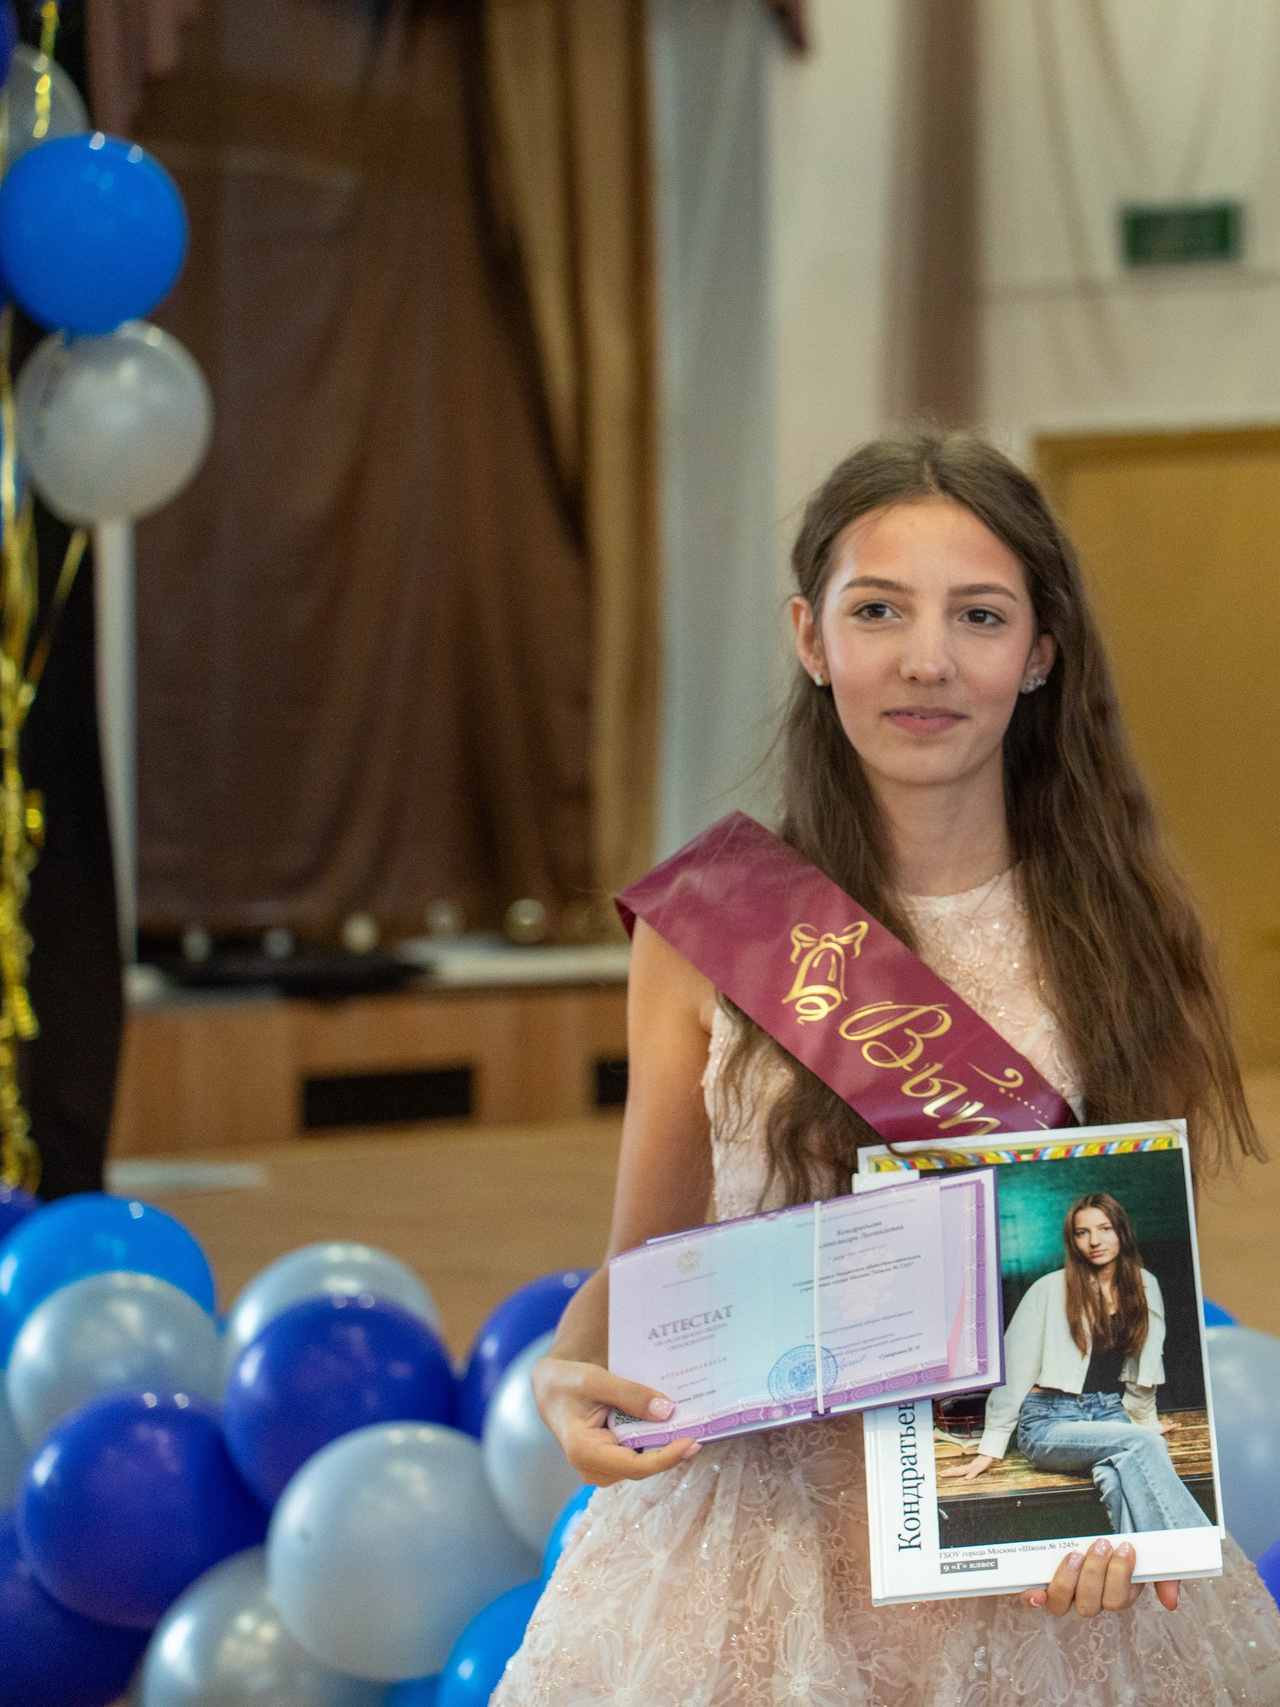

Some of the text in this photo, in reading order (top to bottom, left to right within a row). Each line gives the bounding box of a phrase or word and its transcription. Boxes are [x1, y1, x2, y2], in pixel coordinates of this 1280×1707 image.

[648, 1305, 733, 1340] АТТЕСТАТ
[962, 1550, 986, 1558] города
[988, 1547, 1017, 1556] Москвы
[943, 1564, 950, 1573] 9
[969, 1560, 995, 1569] класс
